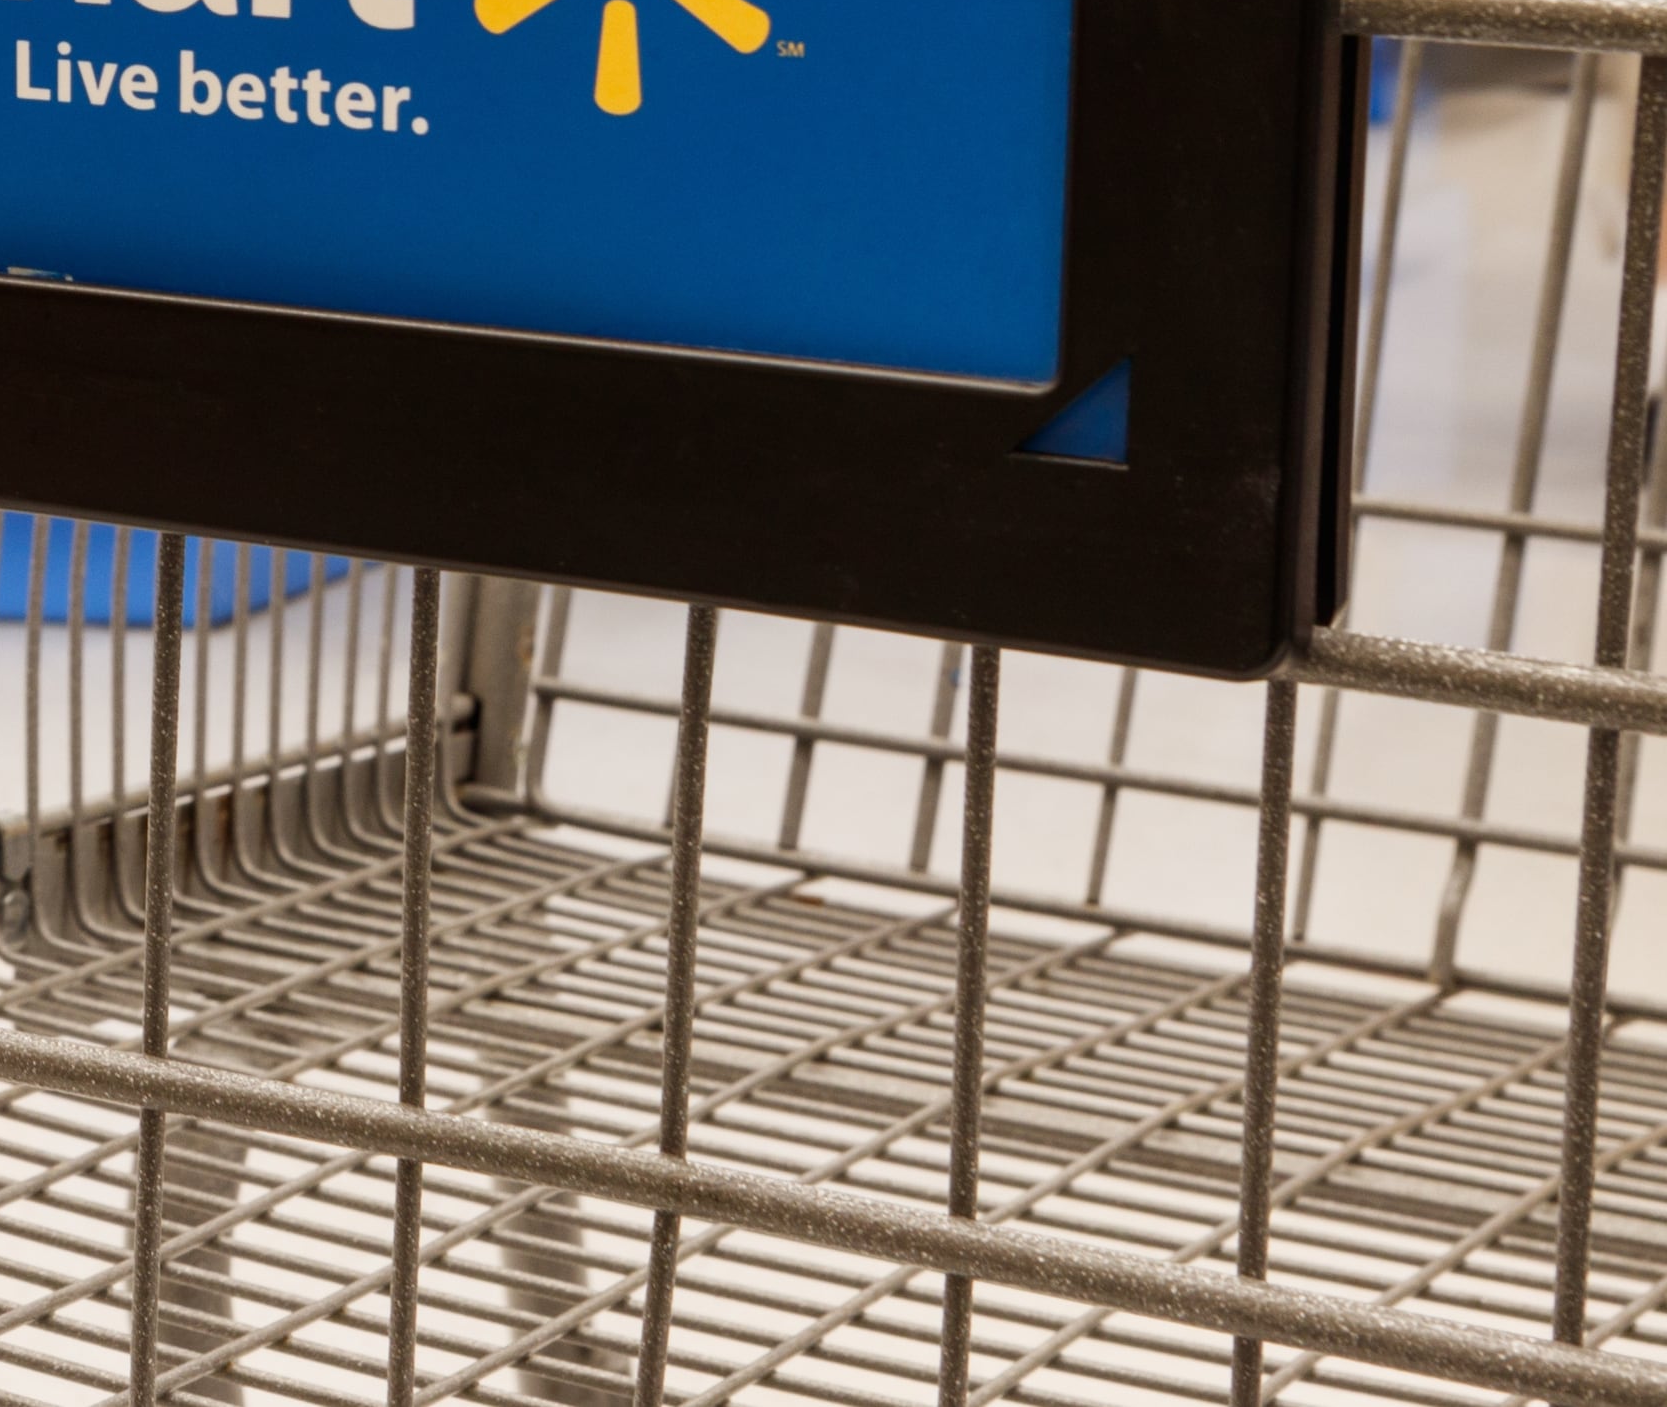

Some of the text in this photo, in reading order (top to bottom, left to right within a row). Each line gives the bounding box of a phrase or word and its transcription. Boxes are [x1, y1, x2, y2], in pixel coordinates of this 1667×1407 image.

[776, 40, 805, 59] SM
[17, 40, 158, 110] Live
[179, 49, 429, 135] better.
